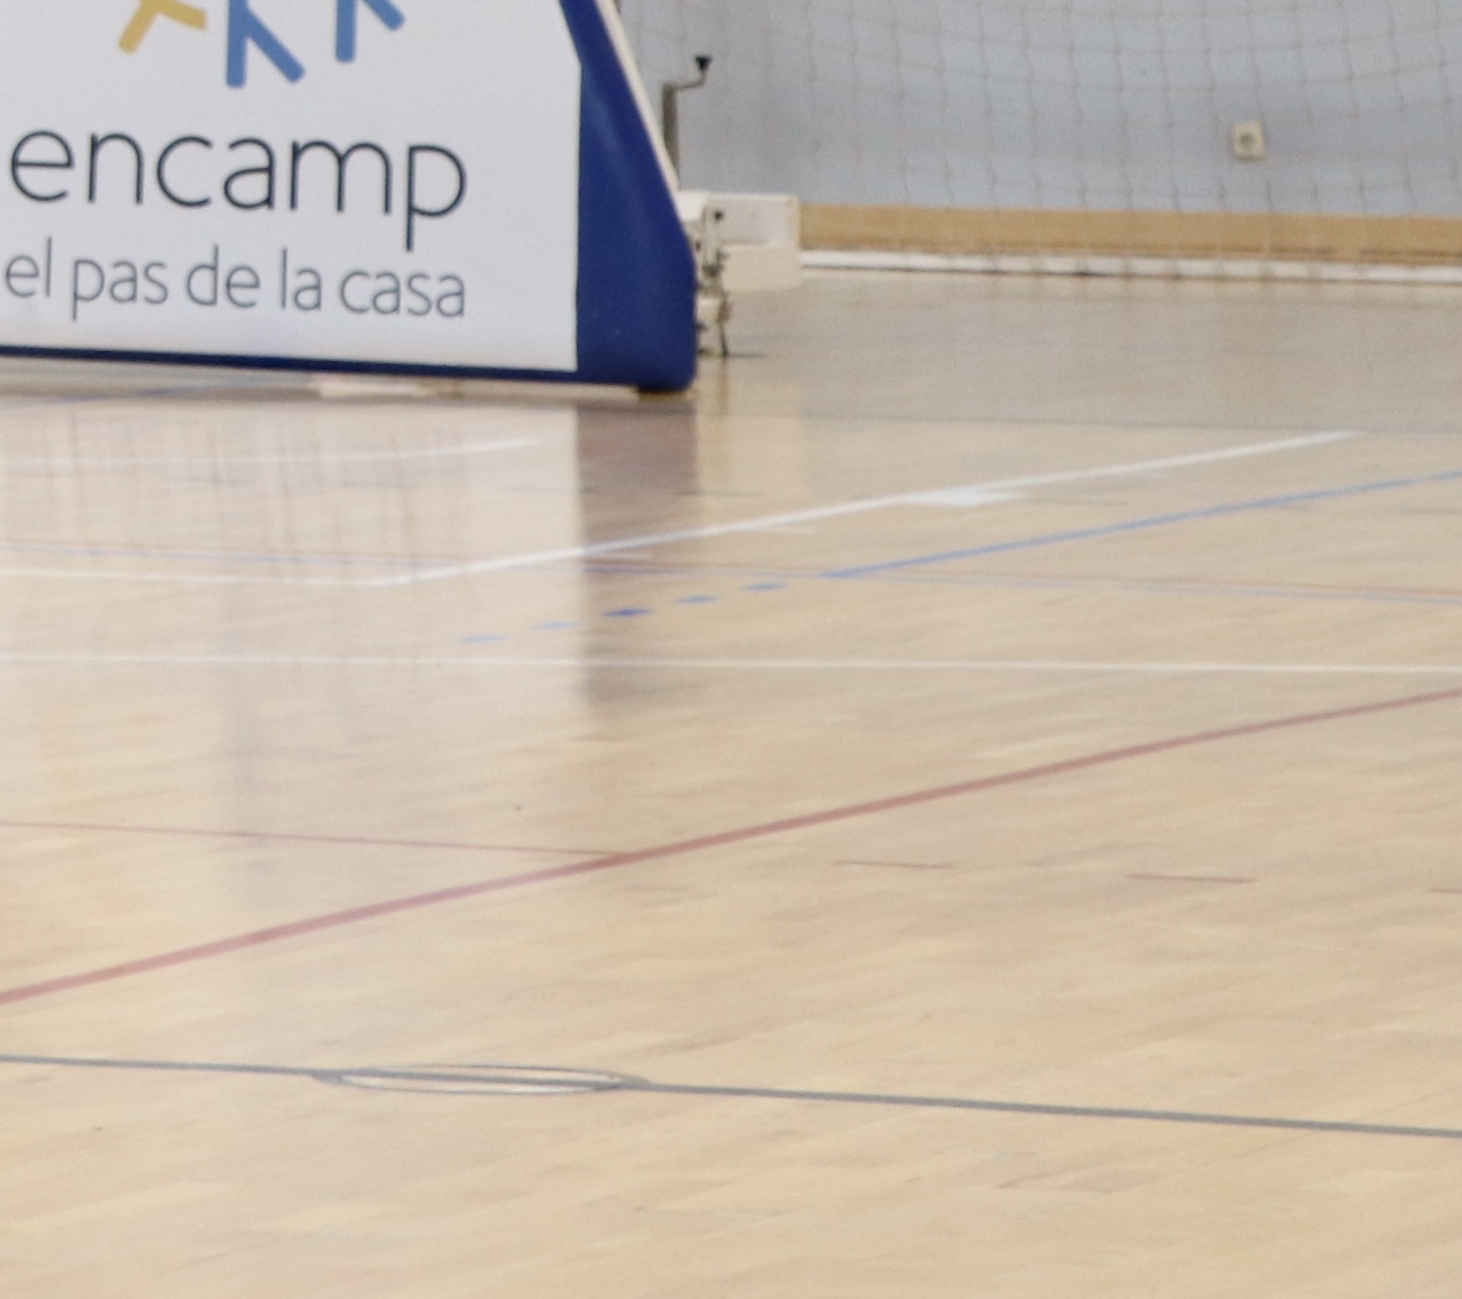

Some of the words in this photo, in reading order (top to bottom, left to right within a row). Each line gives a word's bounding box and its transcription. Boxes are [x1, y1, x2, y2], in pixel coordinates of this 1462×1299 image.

[10, 130, 467, 253] encamp
[4, 236, 52, 299] el
[71, 258, 169, 321] pas
[185, 245, 261, 309] de
[280, 248, 322, 312] la
[339, 269, 465, 318] casa
